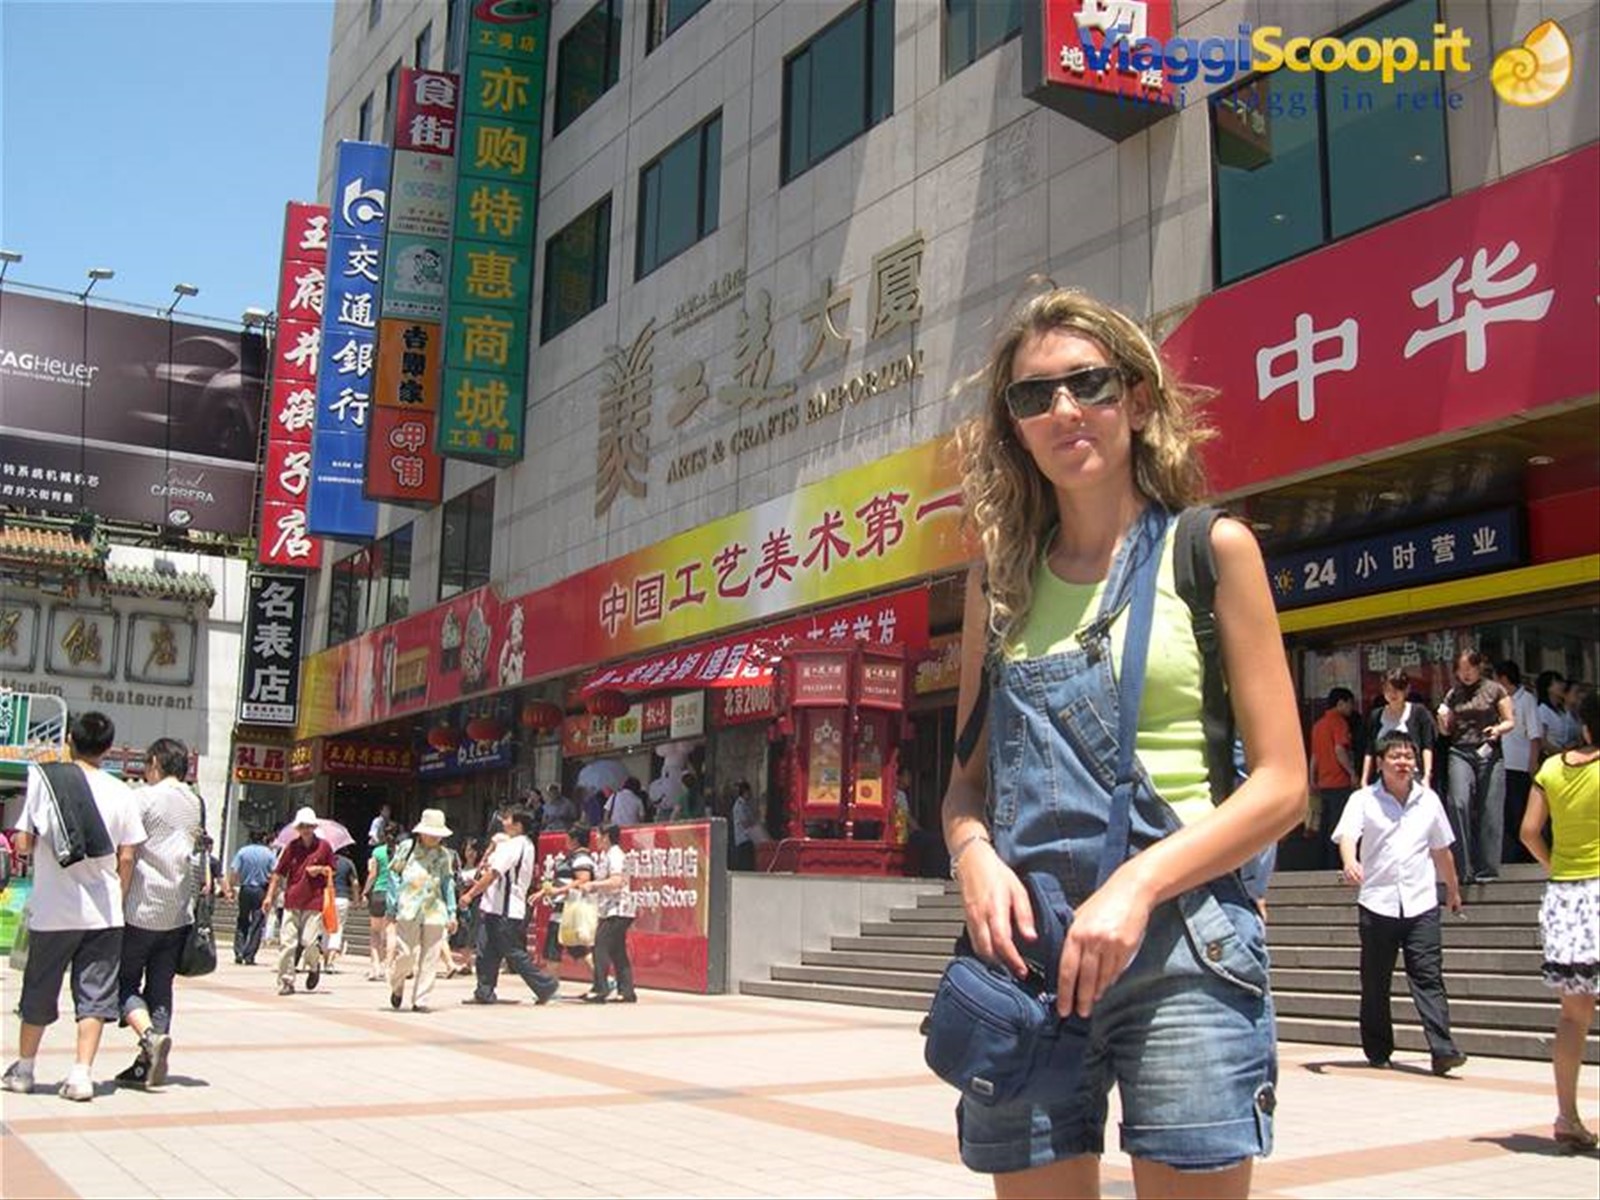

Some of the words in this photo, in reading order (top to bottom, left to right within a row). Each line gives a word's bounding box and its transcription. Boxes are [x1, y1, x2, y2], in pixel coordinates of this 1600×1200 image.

[409, 73, 458, 149] 食街
[455, 66, 530, 429] 亦购特惠商城
[329, 244, 379, 427] 交通銀行
[1255, 240, 1556, 422] 中华
[667, 446, 708, 484] ARTS
[711, 440, 725, 466] &
[729, 406, 800, 454] CRAFTS
[600, 492, 962, 634] 中国工艺美术第一
[89, 684, 193, 710] Restaurant
[249, 580, 296, 702] 名表店
[661, 884, 698, 908] Store
